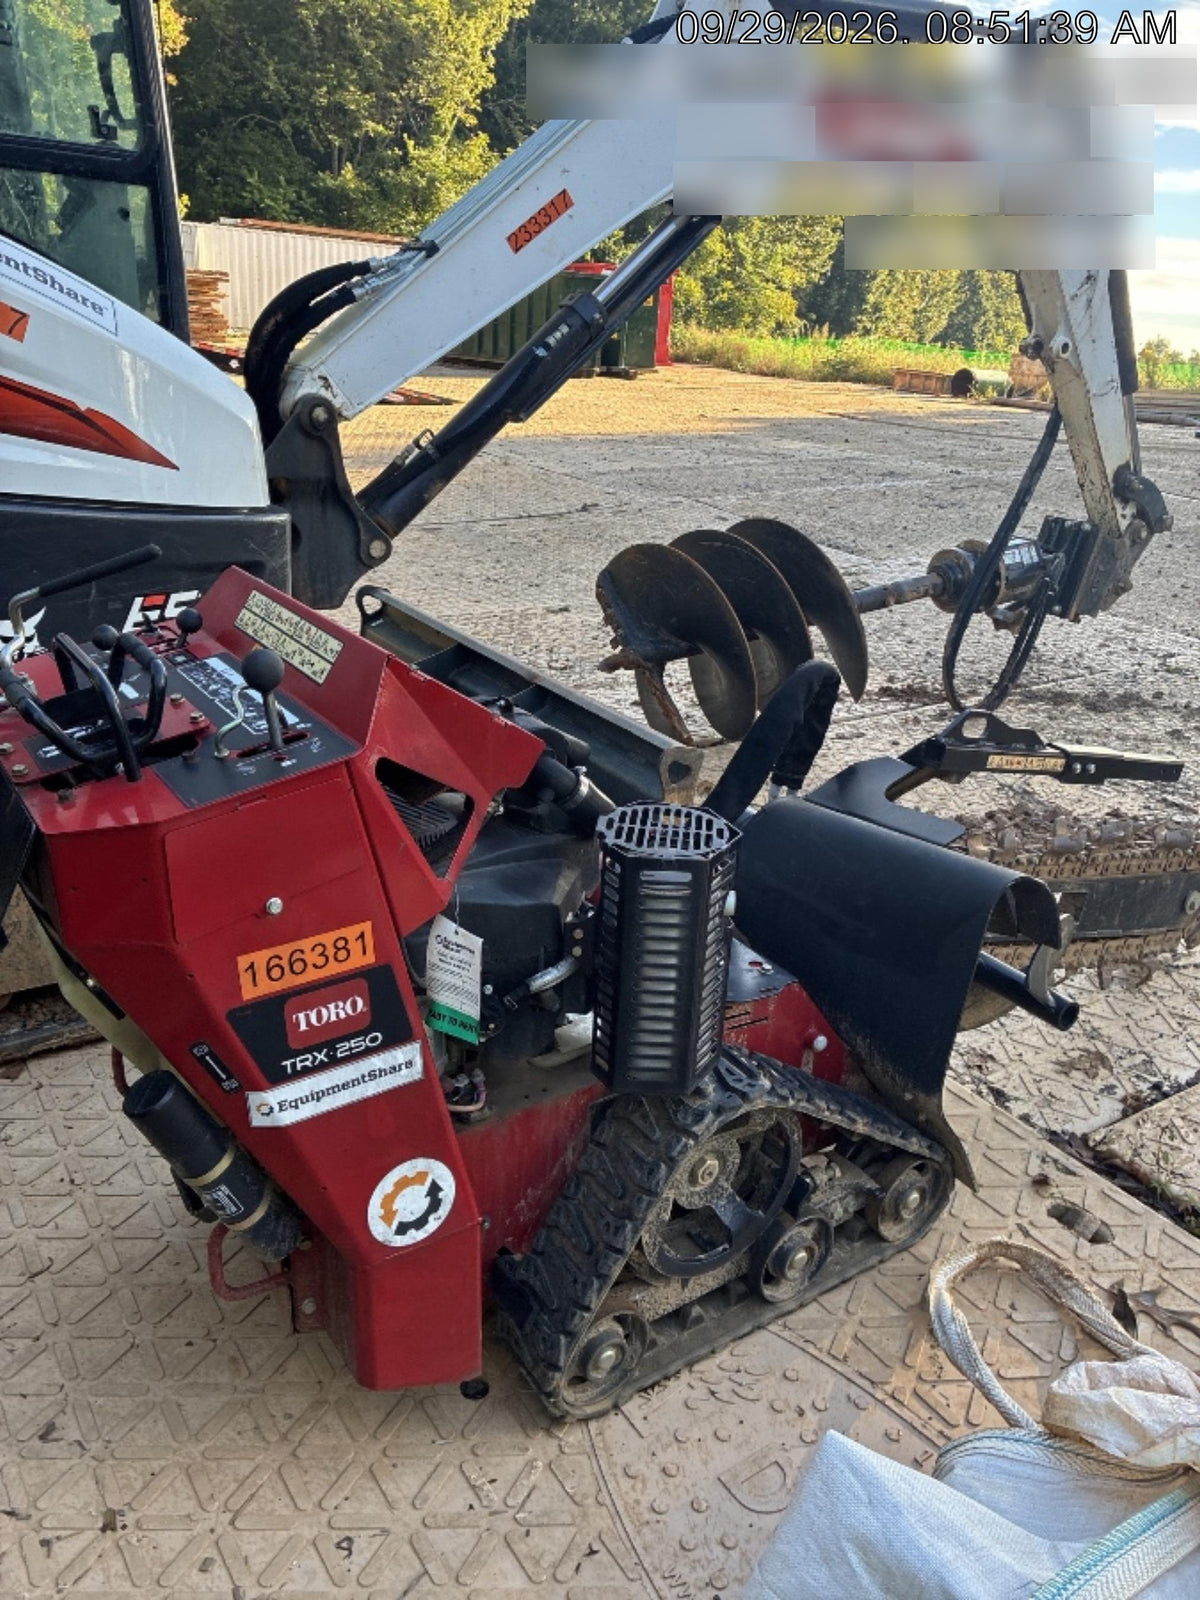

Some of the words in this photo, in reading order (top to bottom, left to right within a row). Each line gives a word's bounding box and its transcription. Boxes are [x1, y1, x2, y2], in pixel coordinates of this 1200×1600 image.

[507, 188, 569, 254] 233317
[244, 931, 368, 988] 166381
[292, 994, 367, 1032] TORO
[277, 1058, 414, 1114] EquipmentShare
